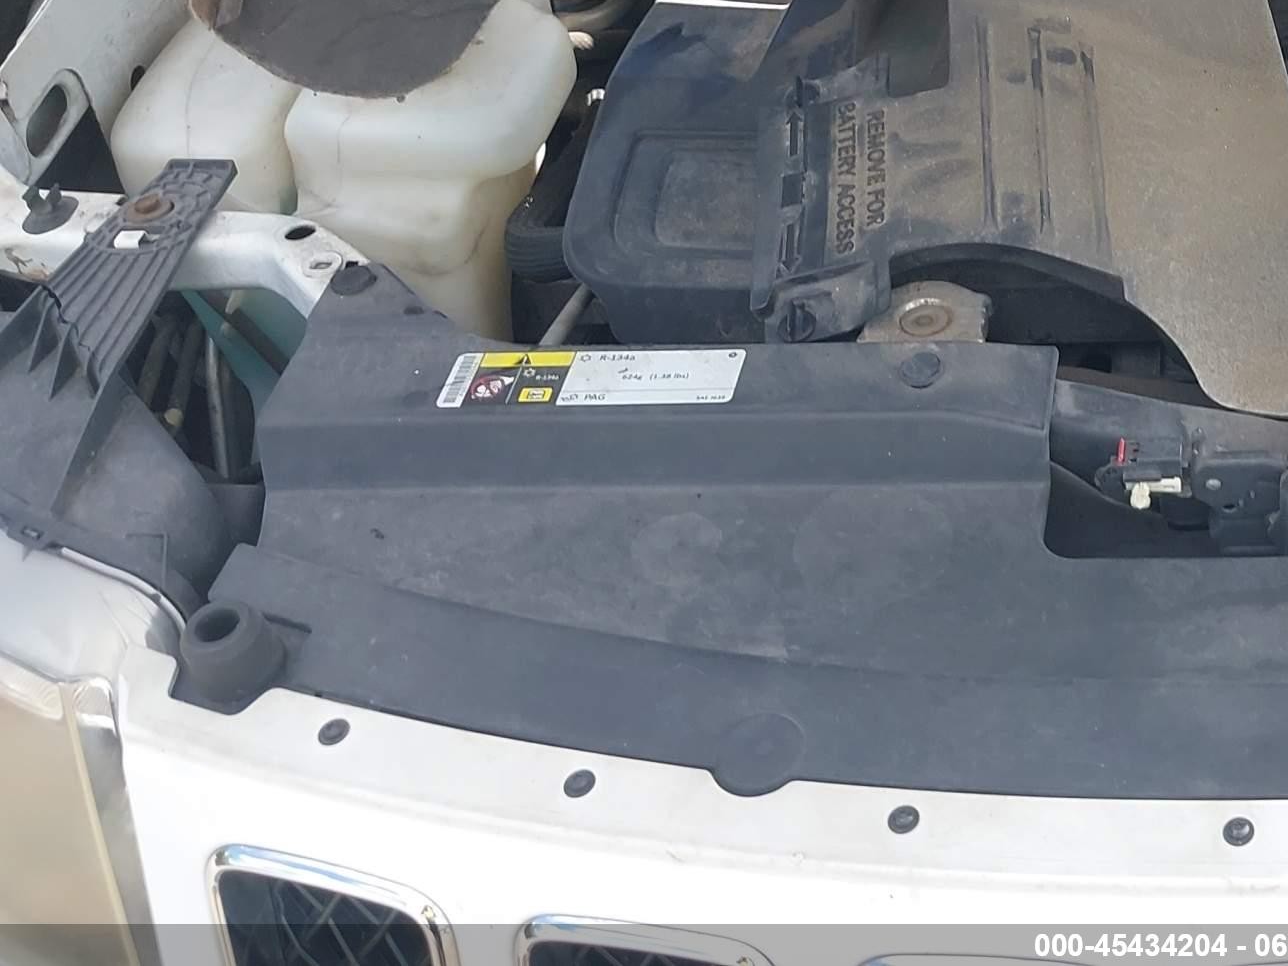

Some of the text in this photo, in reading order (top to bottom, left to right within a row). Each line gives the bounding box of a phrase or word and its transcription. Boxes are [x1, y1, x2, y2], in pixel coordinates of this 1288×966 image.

[835, 101, 857, 255] BATTERY ACCESS
[866, 108, 887, 227] REMOVE FOR
[583, 392, 607, 402] PAG
